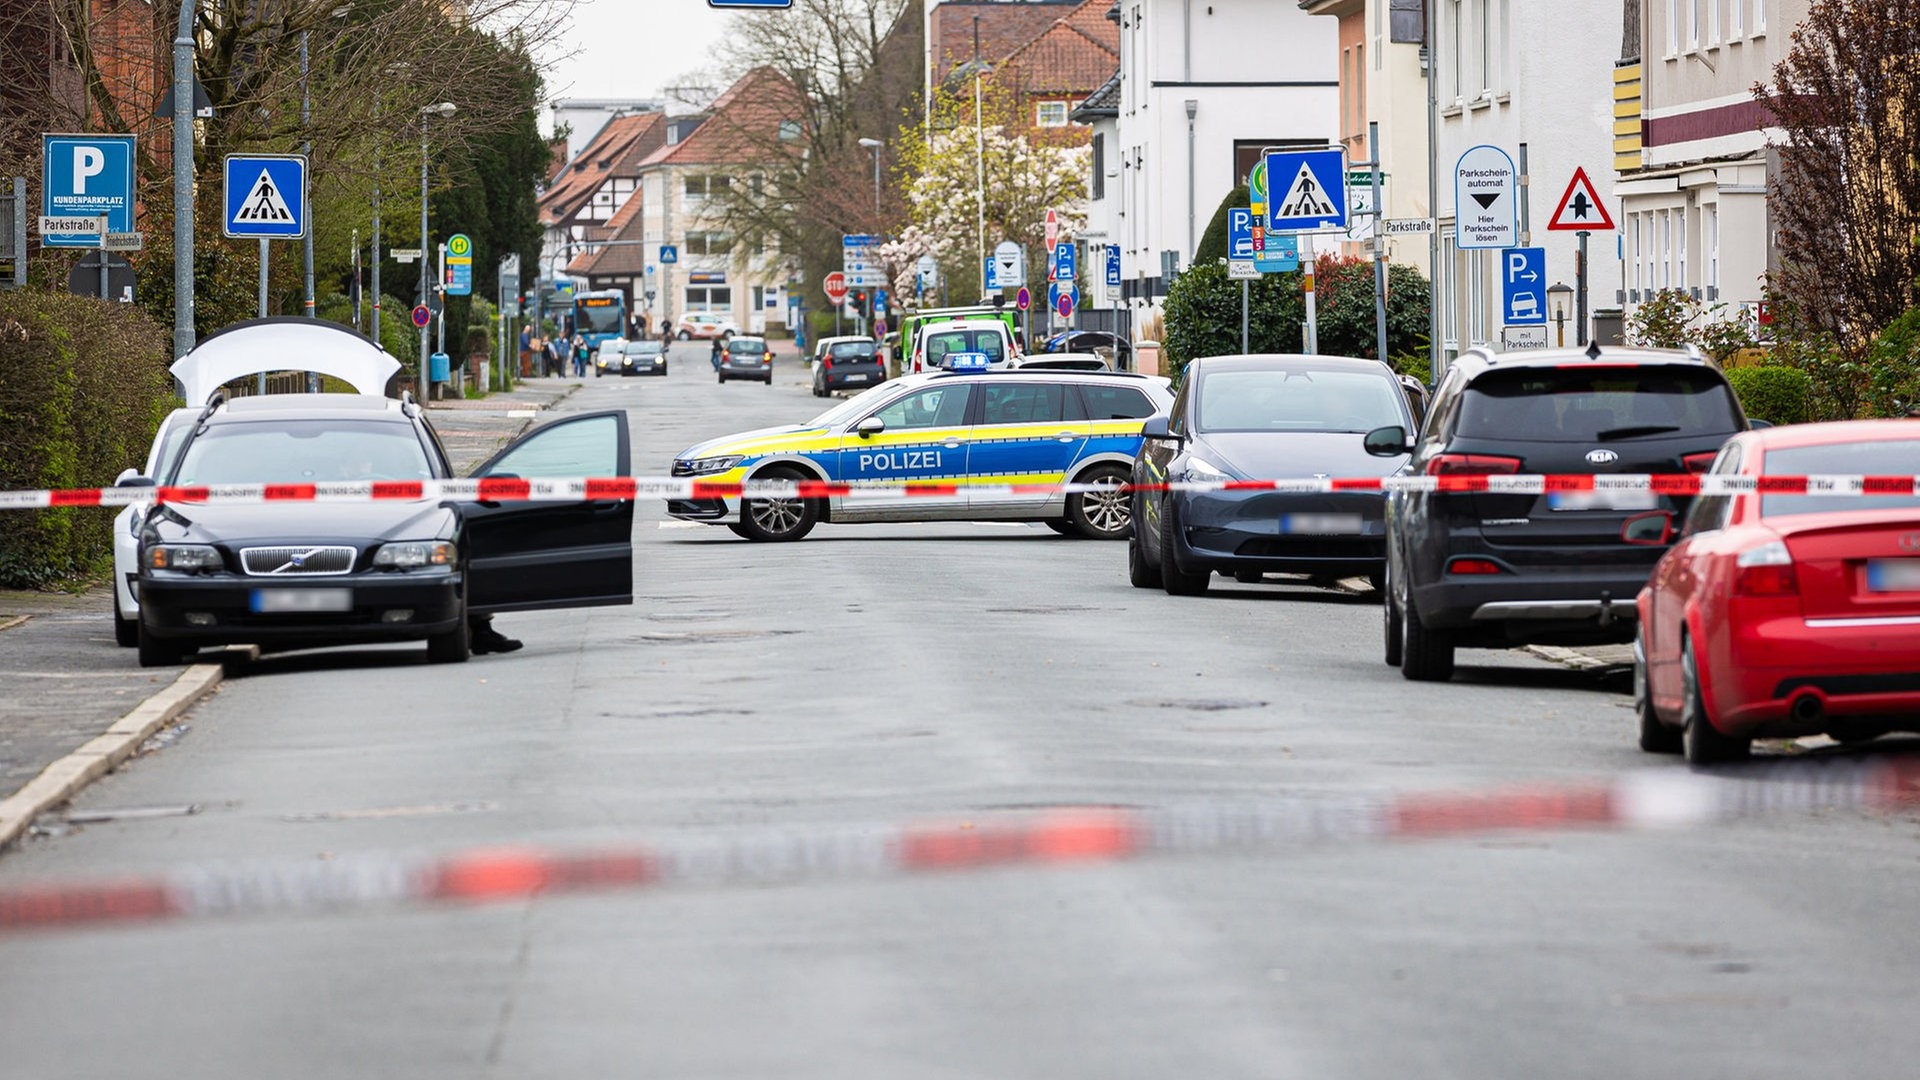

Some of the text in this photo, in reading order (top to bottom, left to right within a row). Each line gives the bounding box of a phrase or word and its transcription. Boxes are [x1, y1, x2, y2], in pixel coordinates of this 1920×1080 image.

[73, 146, 105, 194] P
[1459, 168, 1511, 179] Parkschein-
[1467, 178, 1504, 187] automat
[53, 196, 124, 204] KUNDENPARKPLATZ
[44, 218, 95, 231] Parkstraße
[1234, 212, 1249, 232] P
[1255, 219, 1260, 227] 1
[1477, 215, 1495, 224] Hier
[1386, 220, 1432, 232] Parkstraße
[1464, 223, 1509, 233] Parkschein
[1475, 233, 1498, 242] lösen
[455, 241, 464, 251] H
[1255, 242, 1262, 251] 5
[1060, 246, 1067, 260] P
[1107, 248, 1114, 263] P
[1509, 253, 1528, 283] P
[859, 451, 942, 472] POLIZEI
